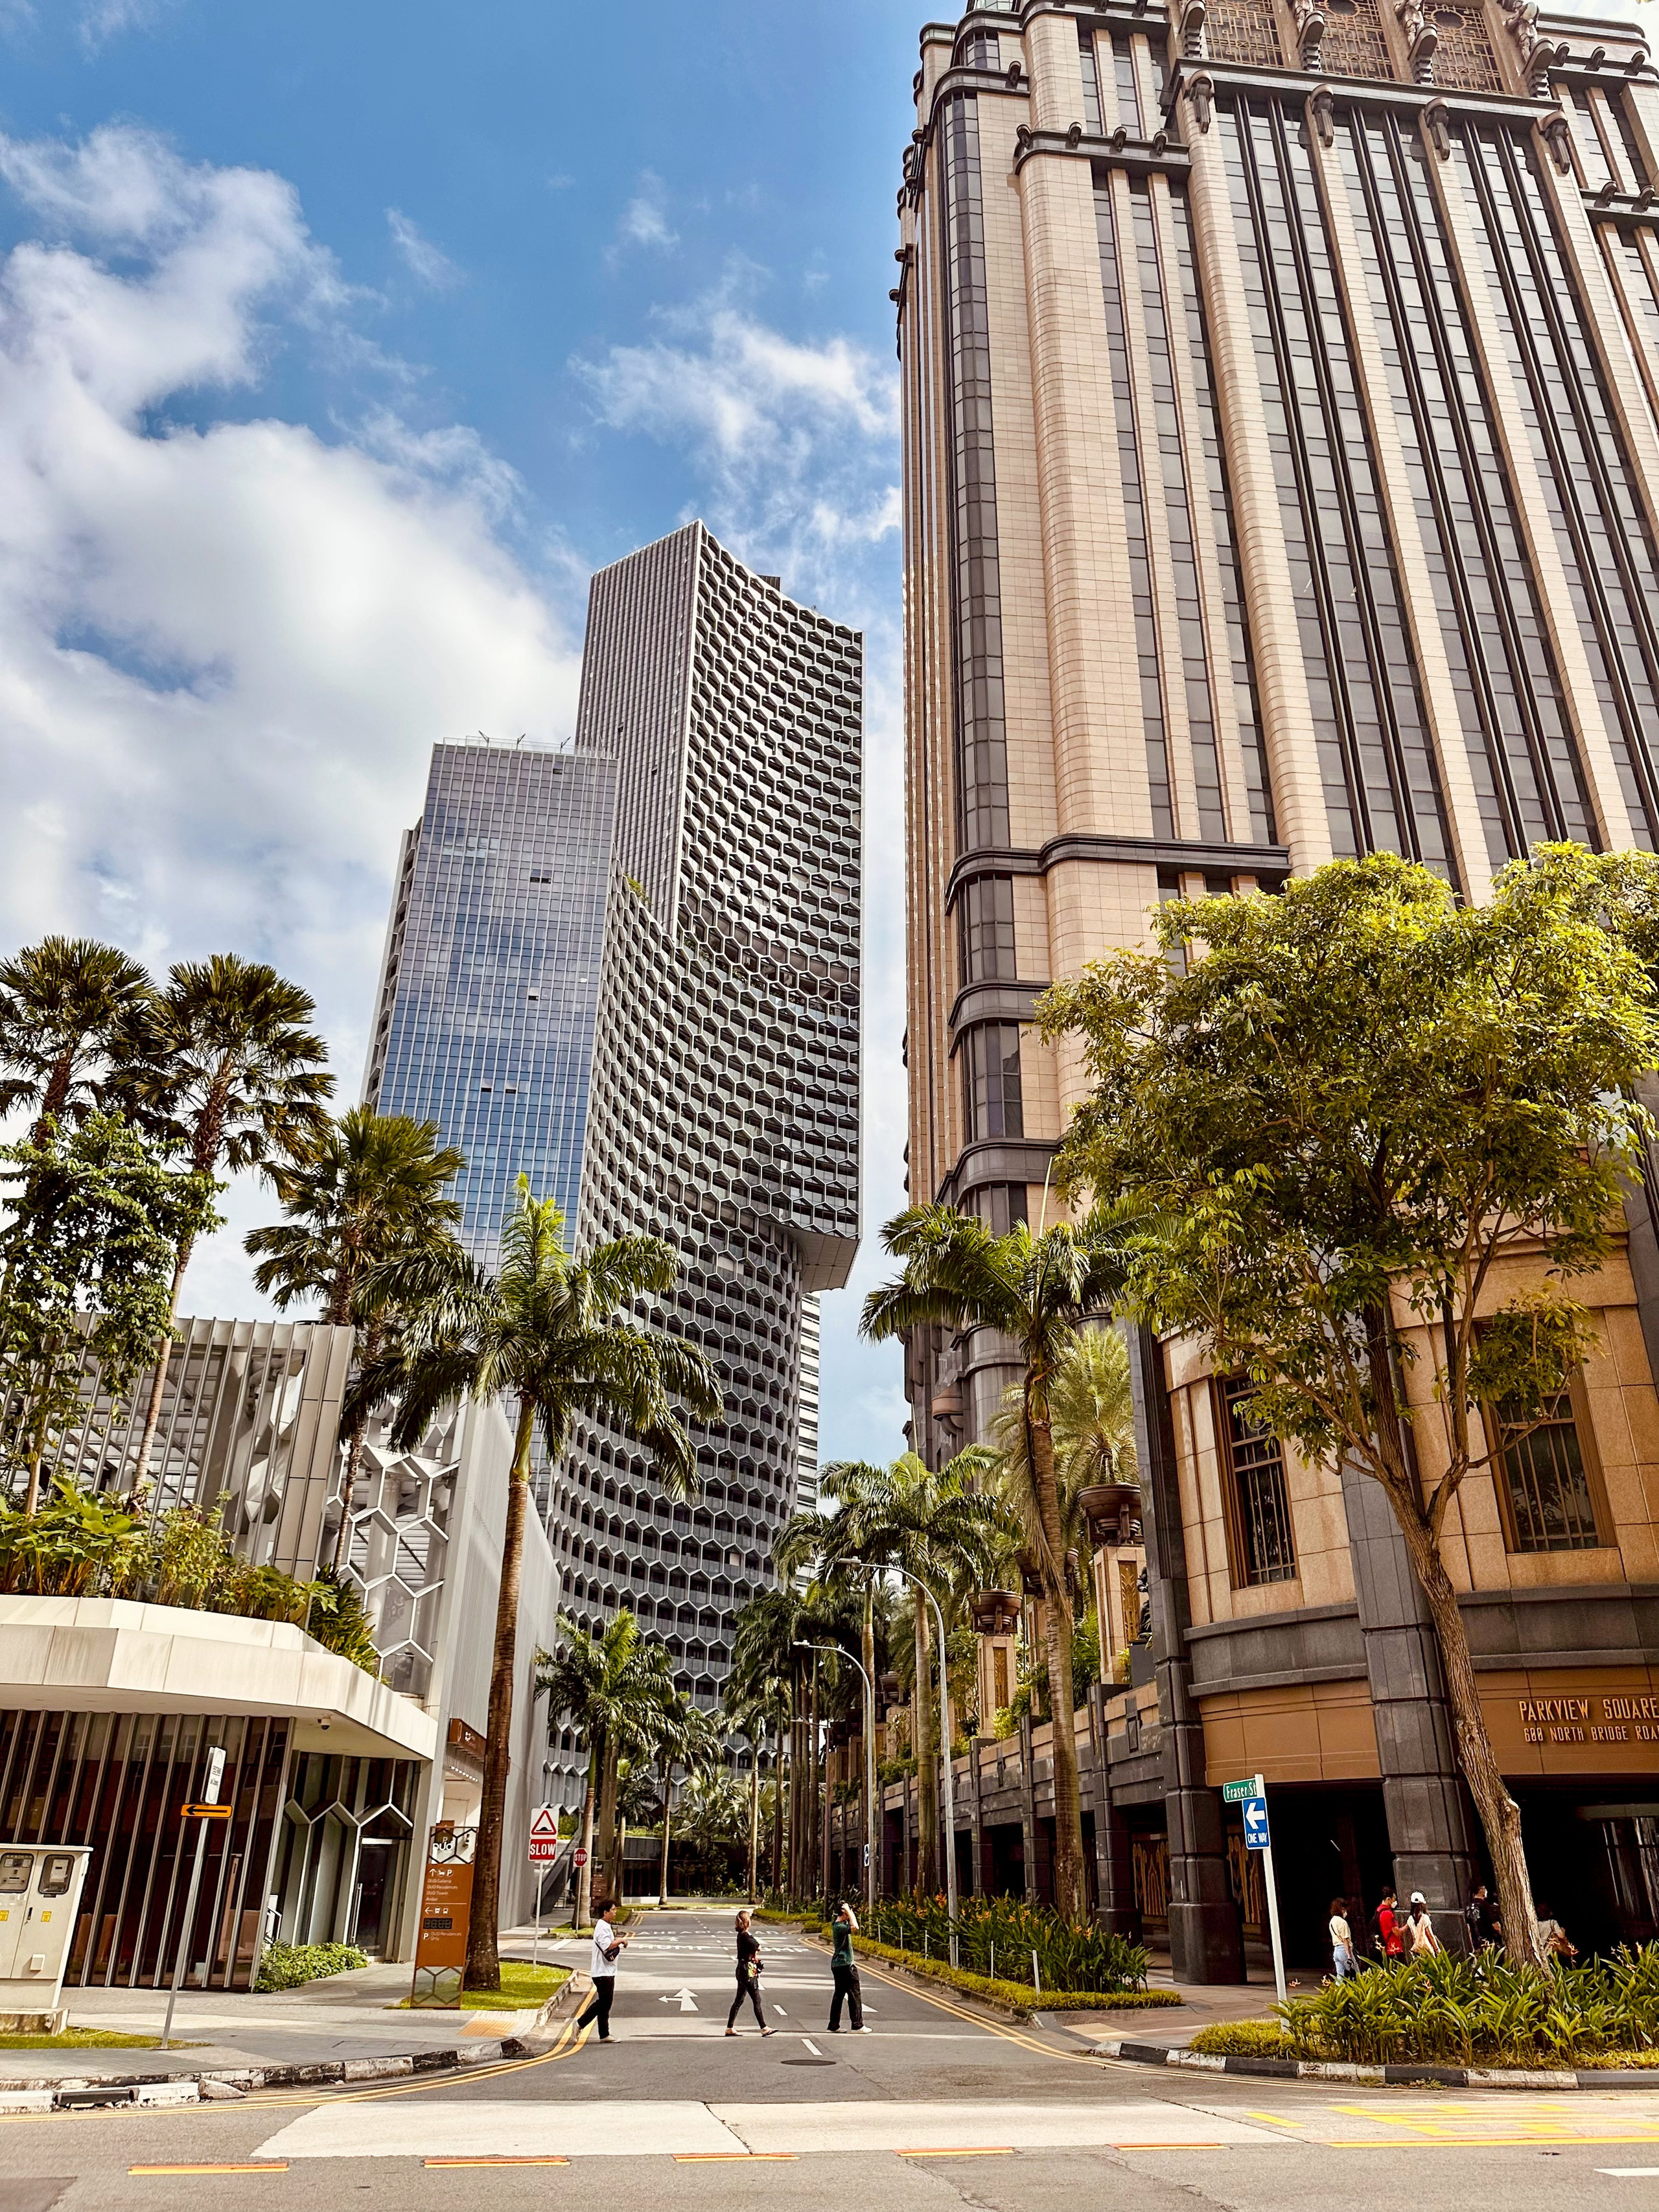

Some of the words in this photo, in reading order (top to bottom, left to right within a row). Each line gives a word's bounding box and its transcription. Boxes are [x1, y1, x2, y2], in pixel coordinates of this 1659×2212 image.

[1518, 1699, 1588, 1721] PARKVIEW
[1603, 1697, 1659, 1719] SQUARE
[1524, 1727, 1544, 1742] 600
[1549, 1727, 1584, 1741] NORTH
[1590, 1725, 1629, 1740] BRIDGE
[1225, 1786, 1247, 1799] Fraser
[1248, 1782, 1257, 1797] St
[1247, 1833, 1258, 1844] ONE
[1258, 1832, 1268, 1843] WAY
[529, 1843, 556, 1856] SLOW
